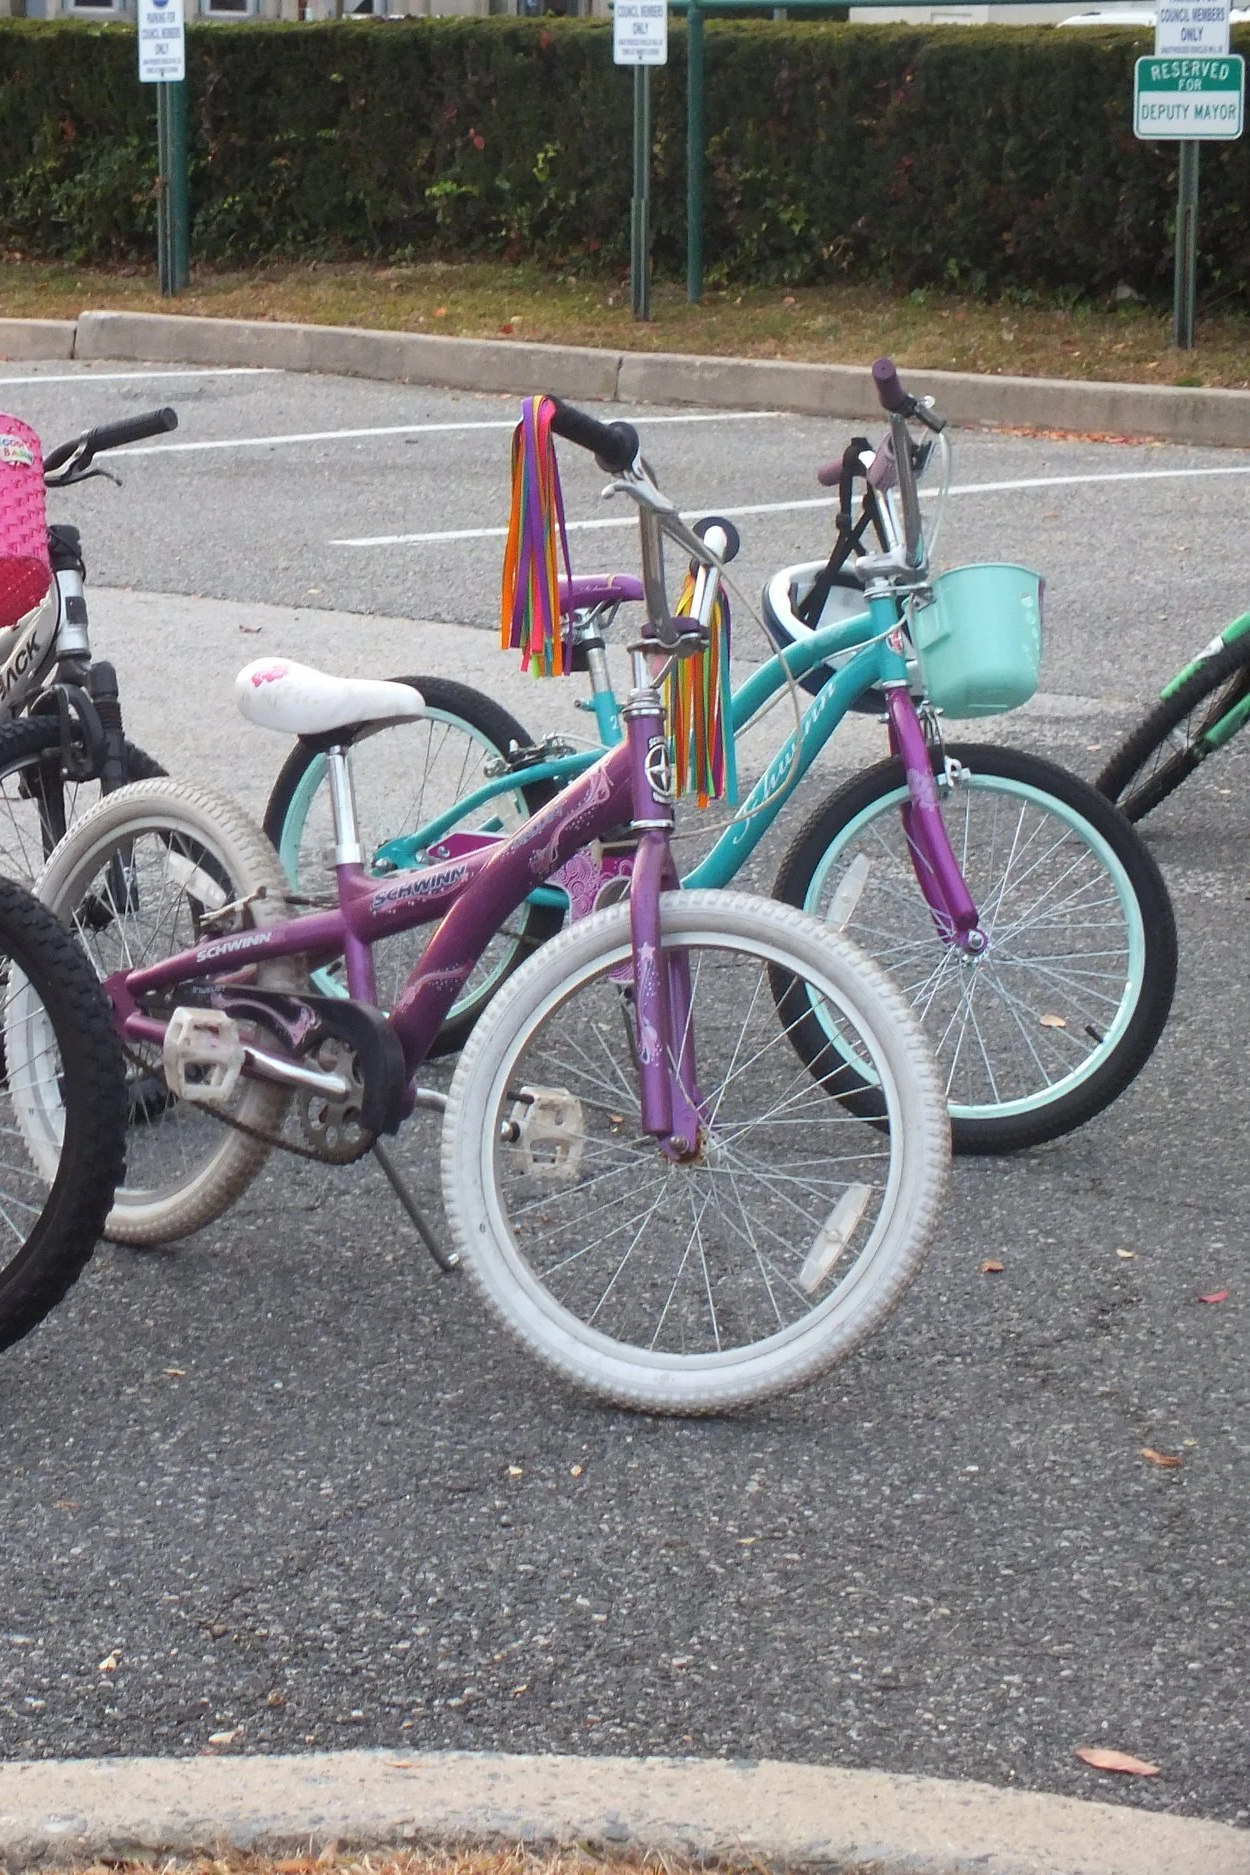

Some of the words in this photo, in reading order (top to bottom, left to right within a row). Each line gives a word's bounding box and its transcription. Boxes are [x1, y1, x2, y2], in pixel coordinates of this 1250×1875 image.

[1160, 8, 1190, 22] COUNCIL
[1192, 8, 1225, 22] MEMBERS
[1181, 27, 1204, 41] ONLY
[1150, 61, 1230, 81] RESERVED
[1178, 78, 1202, 92] FOR
[1141, 103, 1190, 120] DEPUTY
[1193, 104, 1237, 120] MAYOR
[374, 864, 468, 910] SCHWINN
[196, 932, 273, 963] SCHWINN
